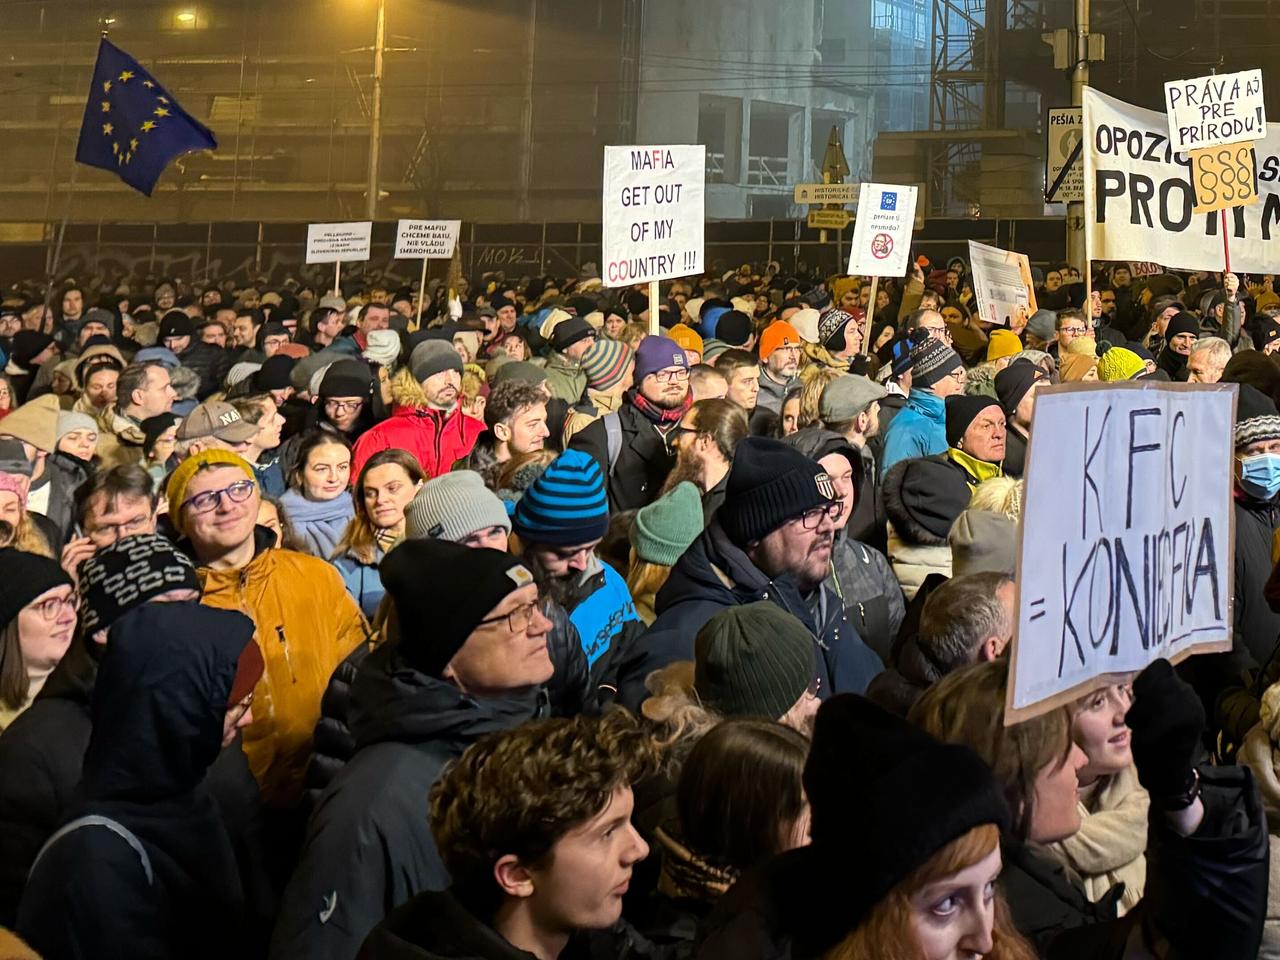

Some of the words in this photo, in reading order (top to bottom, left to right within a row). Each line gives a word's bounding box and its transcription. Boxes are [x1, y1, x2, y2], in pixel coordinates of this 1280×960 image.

[1169, 78, 1240, 109] PRÁVA
[1050, 113, 1074, 125] PEŠIA
[1199, 102, 1235, 120] PRE
[631, 149, 674, 170] MAFIA
[621, 185, 650, 207] GET
[655, 184, 682, 204] OUT
[631, 221, 649, 242] OF
[654, 219, 674, 240] MY
[608, 253, 675, 282] COUNTRY
[1082, 404, 1187, 540] KFC
